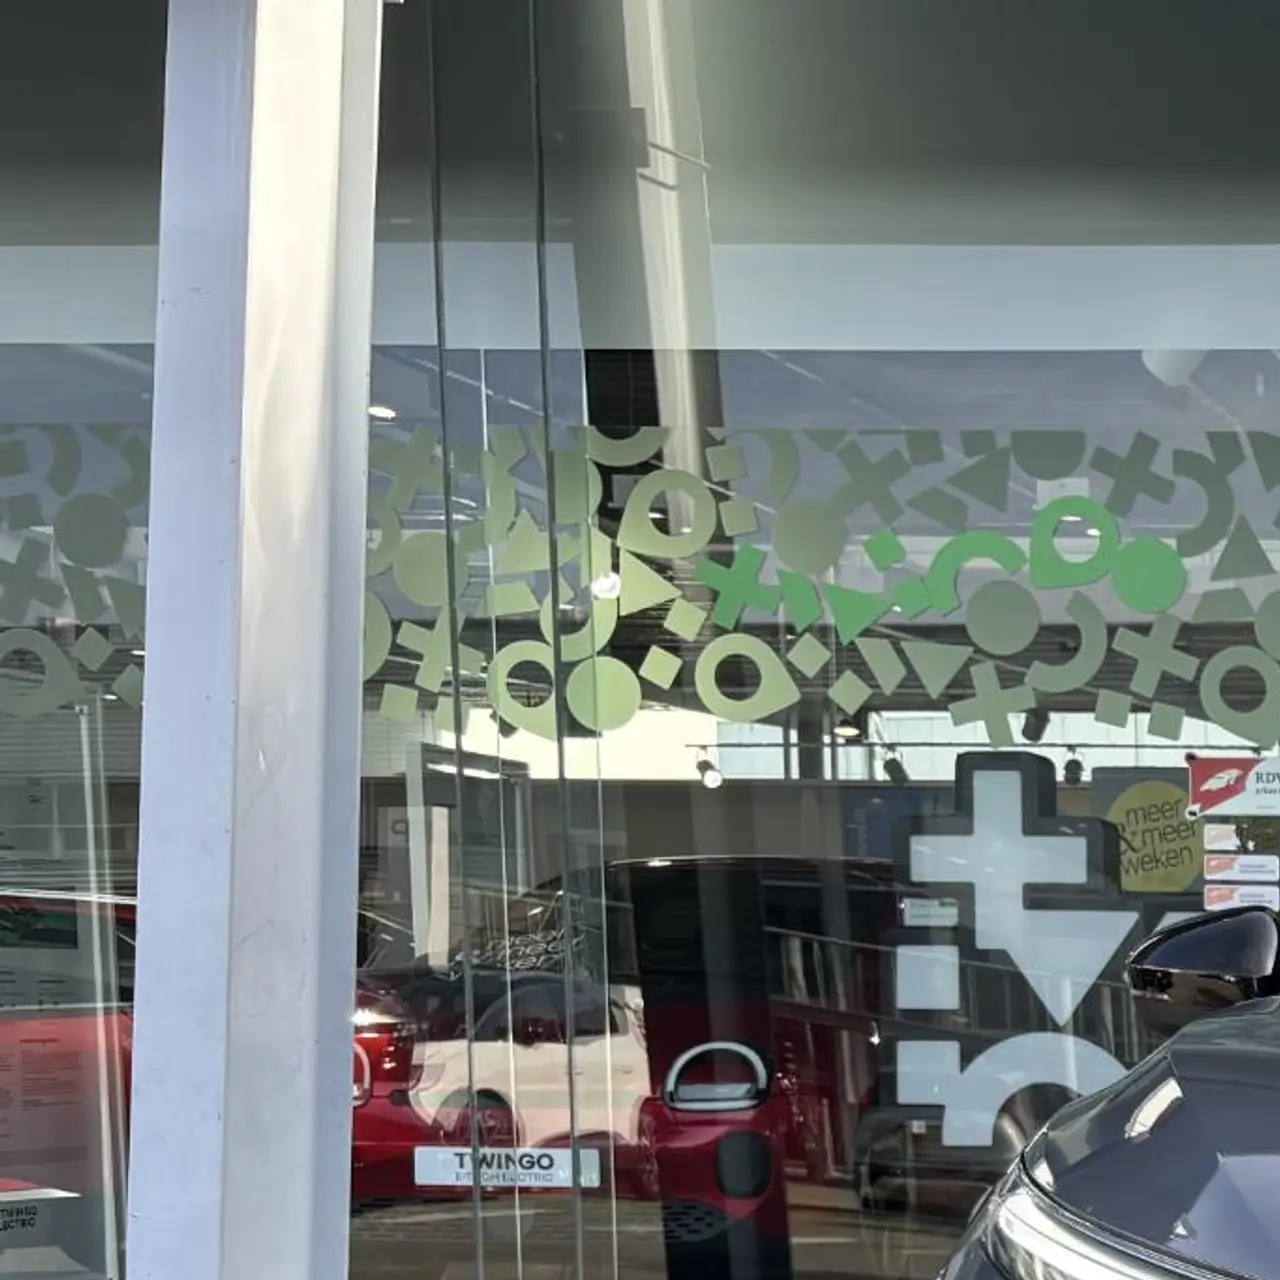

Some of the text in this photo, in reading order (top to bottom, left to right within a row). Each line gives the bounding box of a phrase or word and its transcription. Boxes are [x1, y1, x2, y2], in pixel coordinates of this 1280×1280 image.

[1125, 799, 1182, 827] meer
[1141, 819, 1197, 847] meer
[1120, 838, 1195, 876] weken
[453, 1152, 555, 1170] TWINGO
